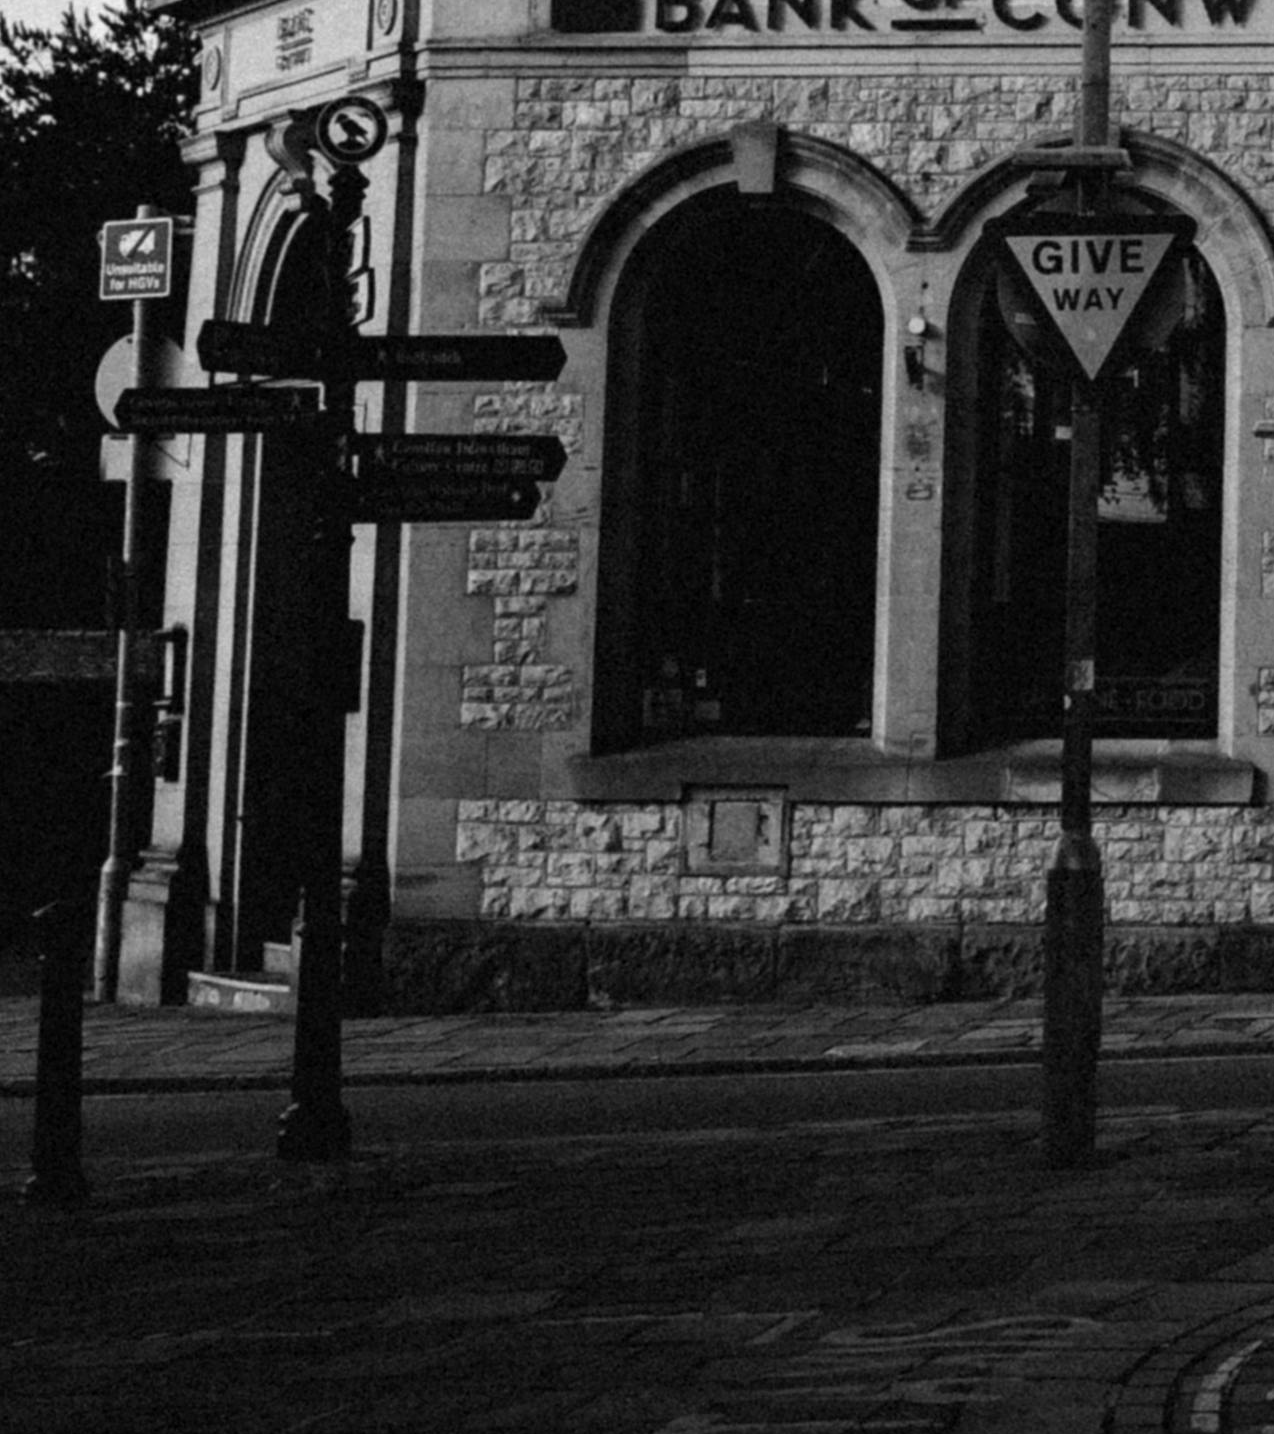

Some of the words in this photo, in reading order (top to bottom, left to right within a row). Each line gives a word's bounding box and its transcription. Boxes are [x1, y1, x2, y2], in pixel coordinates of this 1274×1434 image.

[1032, 239, 1145, 275] GIVE
[110, 279, 126, 291] for
[128, 277, 161, 290] HGVs
[1053, 287, 1125, 311] WAY
